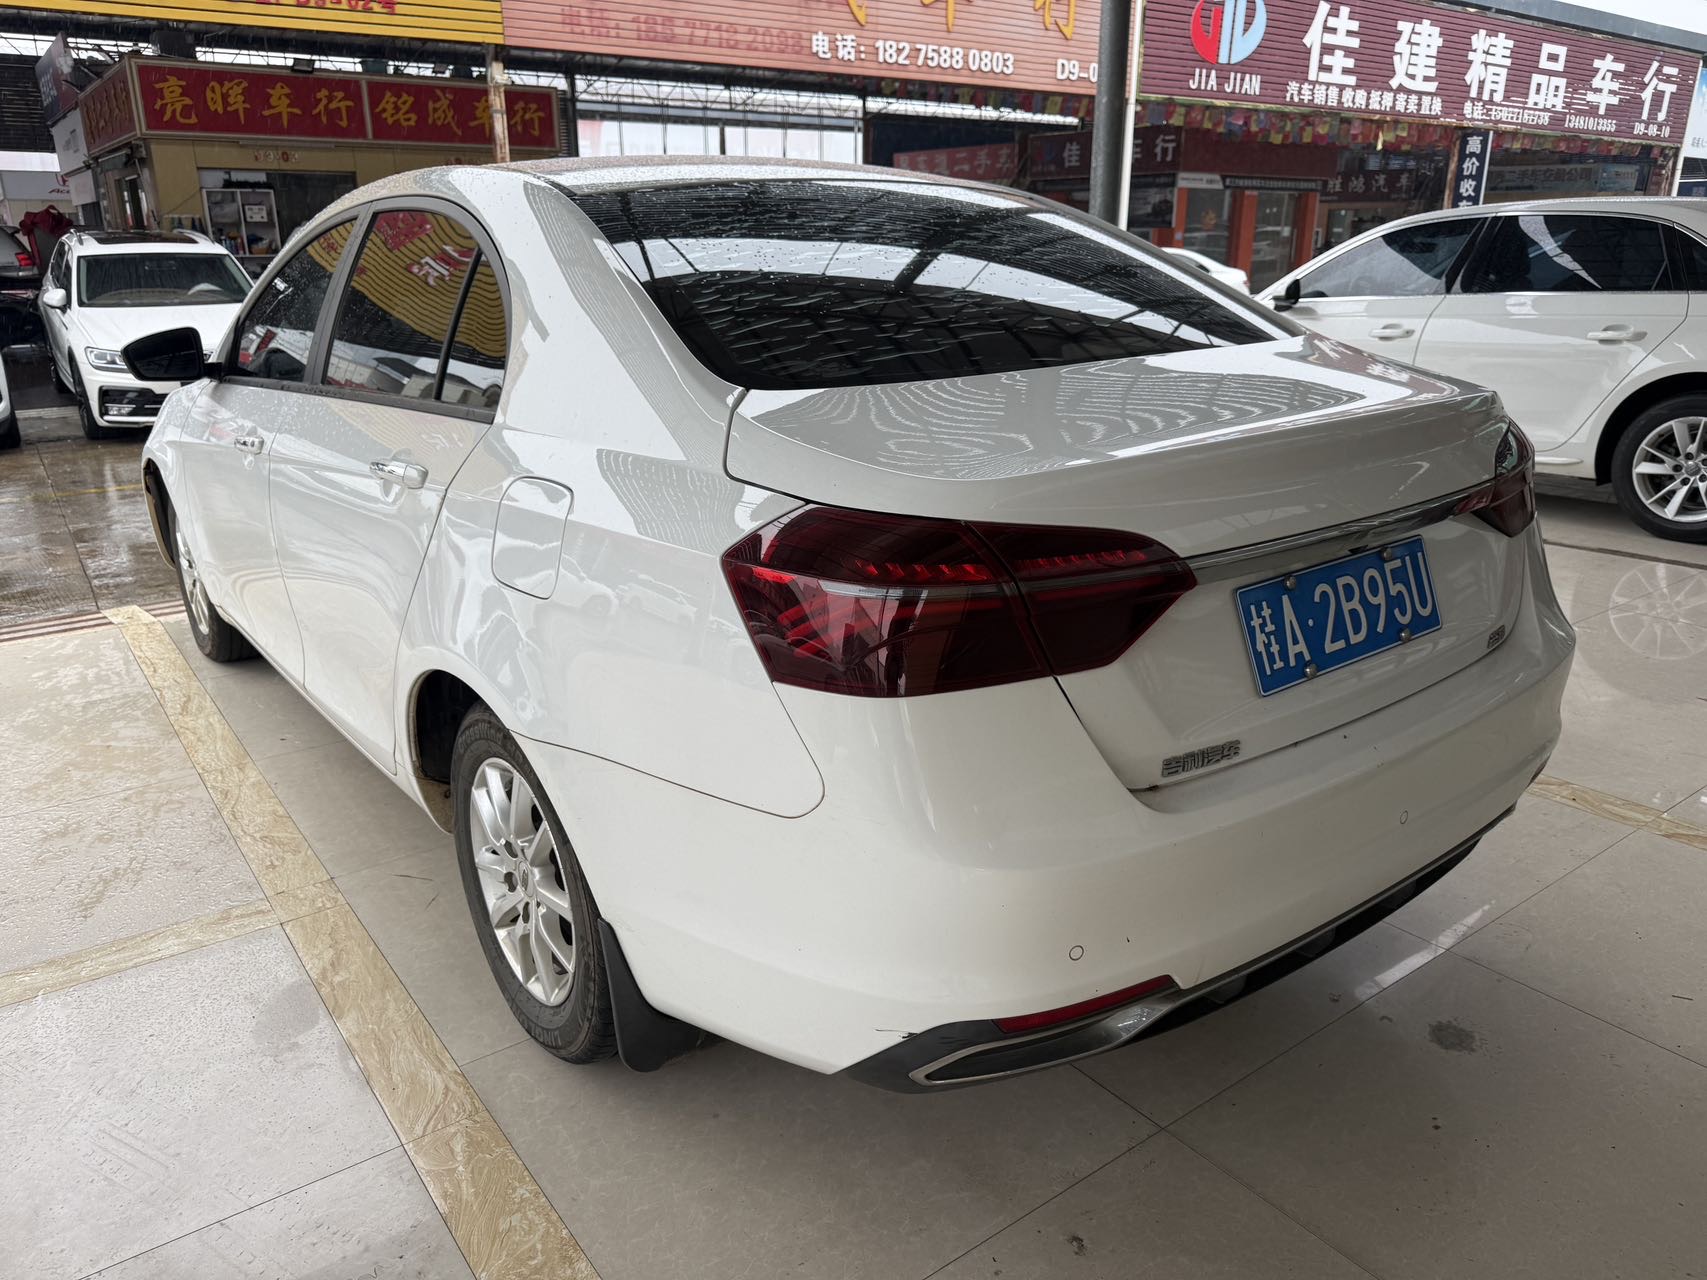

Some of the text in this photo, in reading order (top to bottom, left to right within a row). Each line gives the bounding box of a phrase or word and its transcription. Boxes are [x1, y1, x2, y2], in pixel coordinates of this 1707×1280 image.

[811, 31, 866, 61] 电话：
[875, 39, 911, 65] 182
[915, 44, 963, 70] 7588
[968, 49, 1015, 75] 0803
[1302, 0, 1680, 122] 佳建精品车行
[152, 75, 355, 129] 亮晖车行
[1189, 68, 1261, 96] JIA JIAN
[374, 89, 546, 138] 铭成车行
[1633, 122, 1671, 138] D9-08-10
[1250, 551, 1434, 676] 桂A·2B95U
